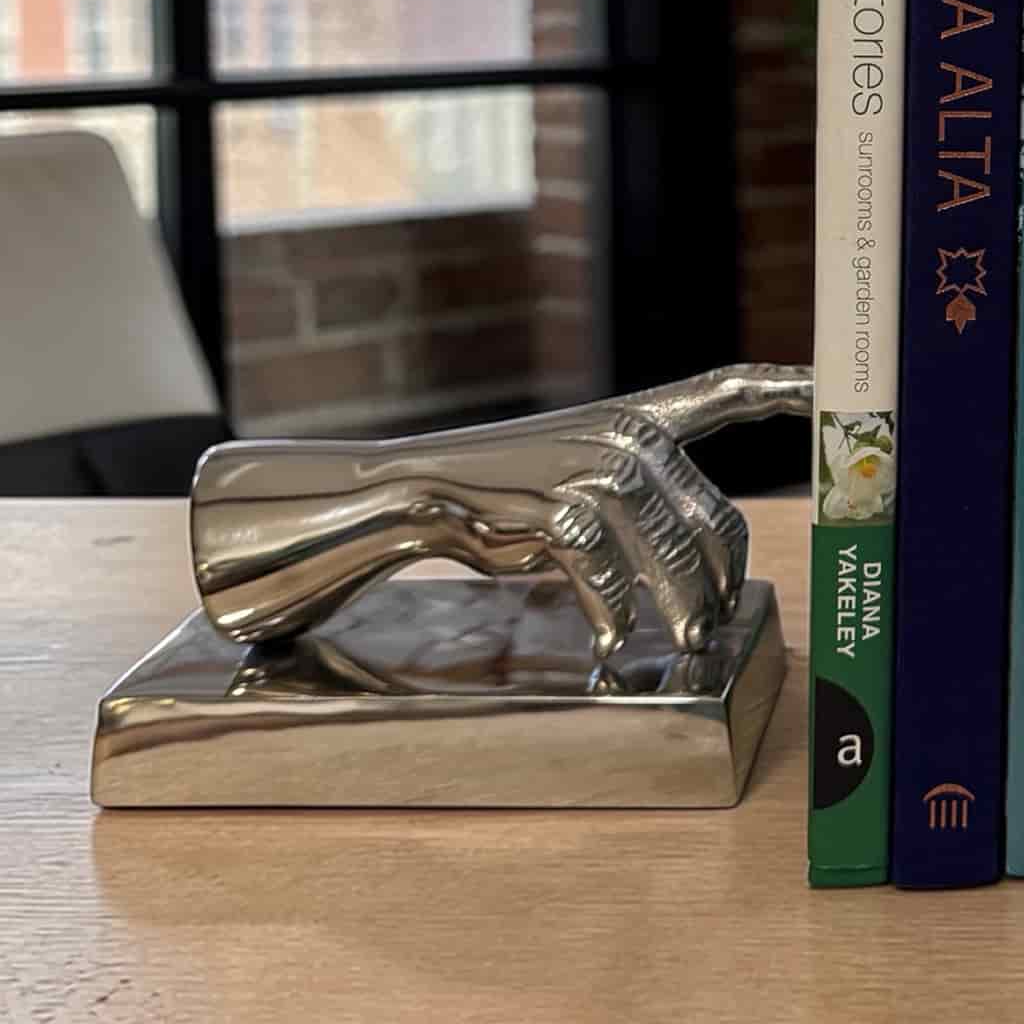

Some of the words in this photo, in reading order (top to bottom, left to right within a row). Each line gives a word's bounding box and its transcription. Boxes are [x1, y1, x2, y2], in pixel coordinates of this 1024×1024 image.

[936, 61, 993, 213] ALTA
[855, 131, 874, 234] sunrooms
[856, 237, 877, 251] &
[851, 256, 876, 325] garden
[853, 331, 871, 393] rooms
[836, 543, 858, 658] YAKELEY
[861, 561, 882, 641] DIANA
[837, 734, 863, 766] a
